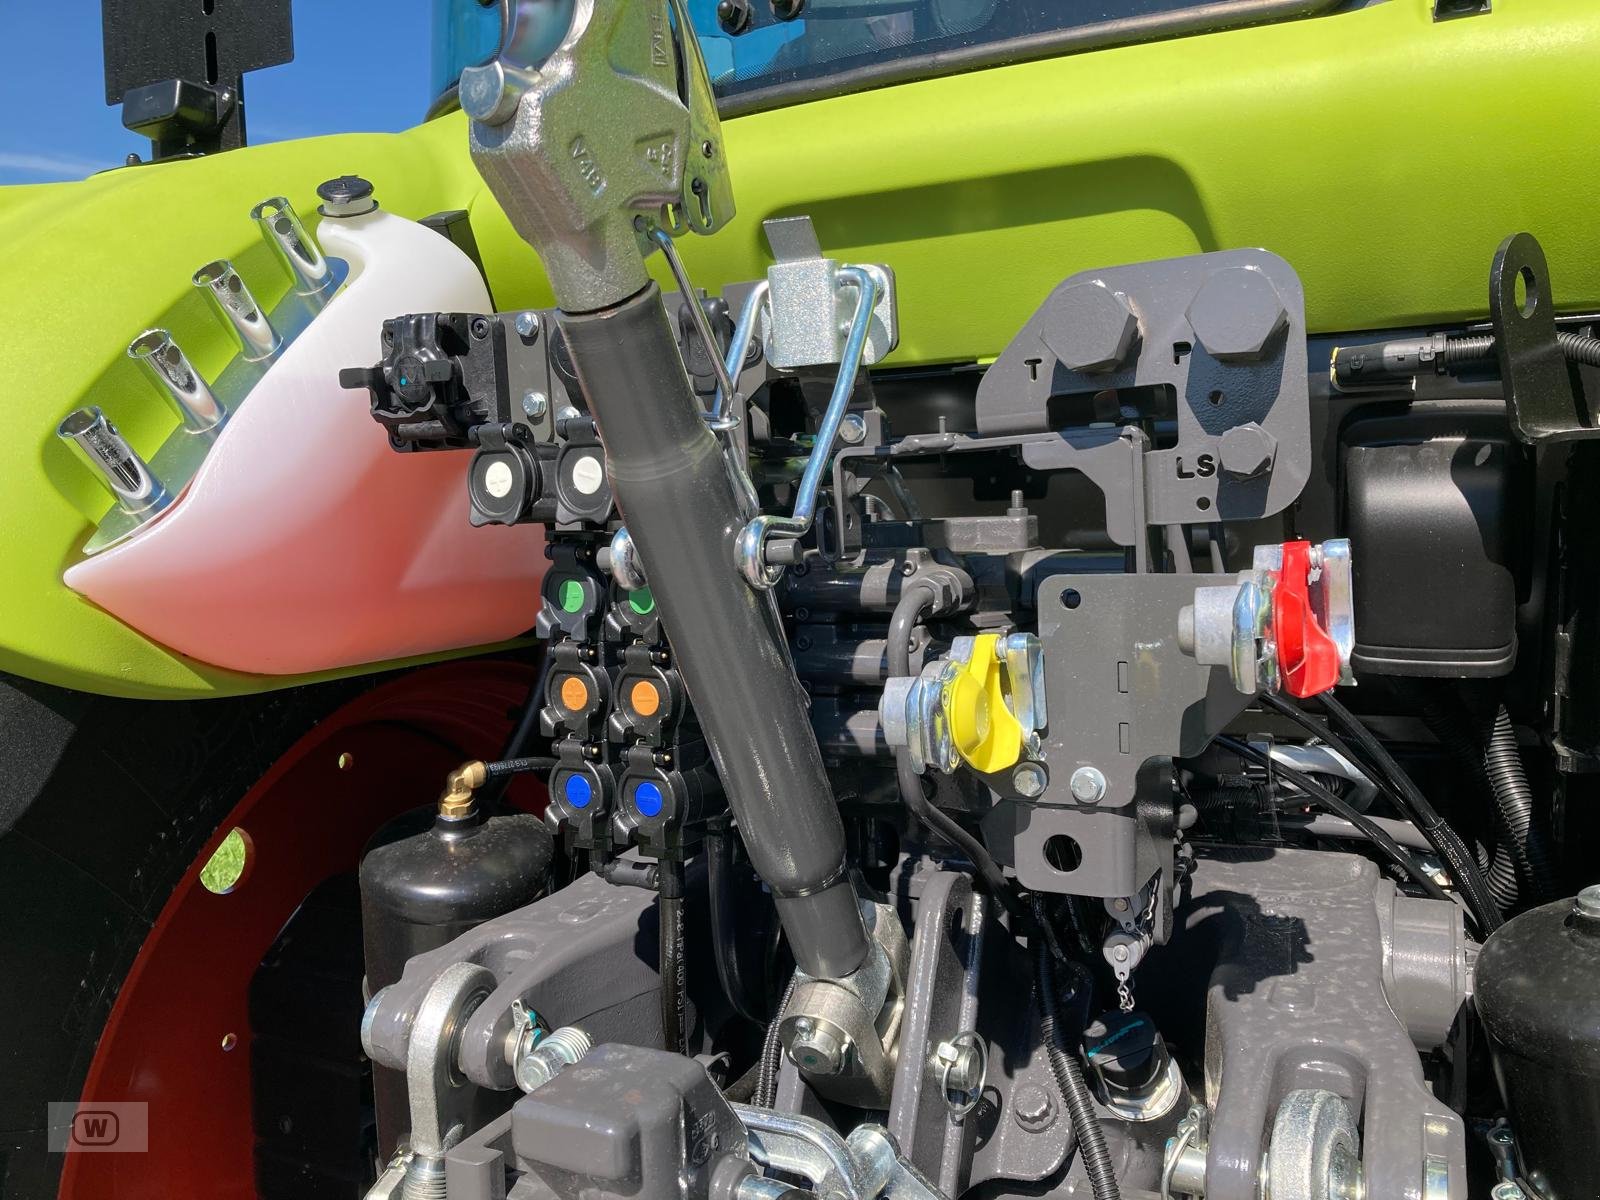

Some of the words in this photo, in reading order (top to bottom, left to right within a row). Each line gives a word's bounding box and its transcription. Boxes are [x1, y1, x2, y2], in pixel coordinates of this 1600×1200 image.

[1172, 341, 1192, 365] P
[1024, 358, 1043, 381] T
[1176, 453, 1216, 479] LS
